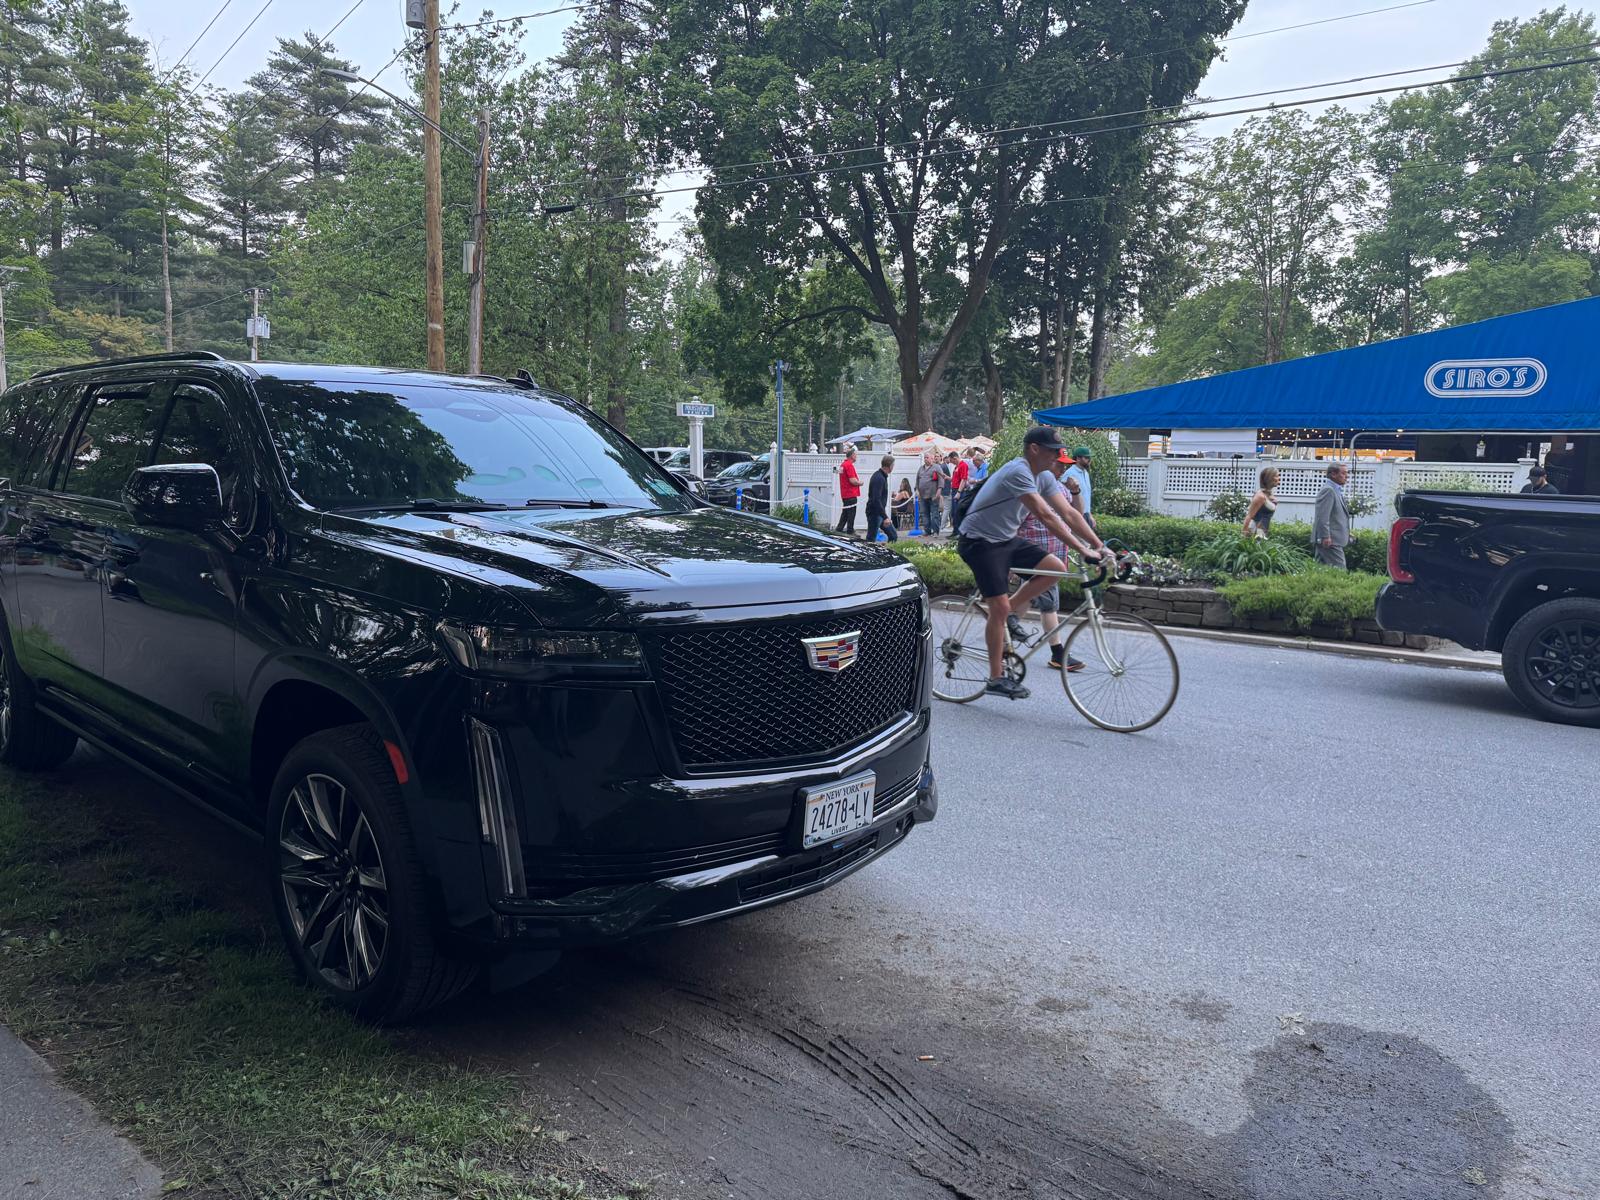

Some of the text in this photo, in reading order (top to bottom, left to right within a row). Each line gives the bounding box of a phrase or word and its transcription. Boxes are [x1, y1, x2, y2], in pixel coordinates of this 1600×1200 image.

[1442, 367, 1528, 389] SIRO'S
[825, 784, 860, 802] NEW YORK
